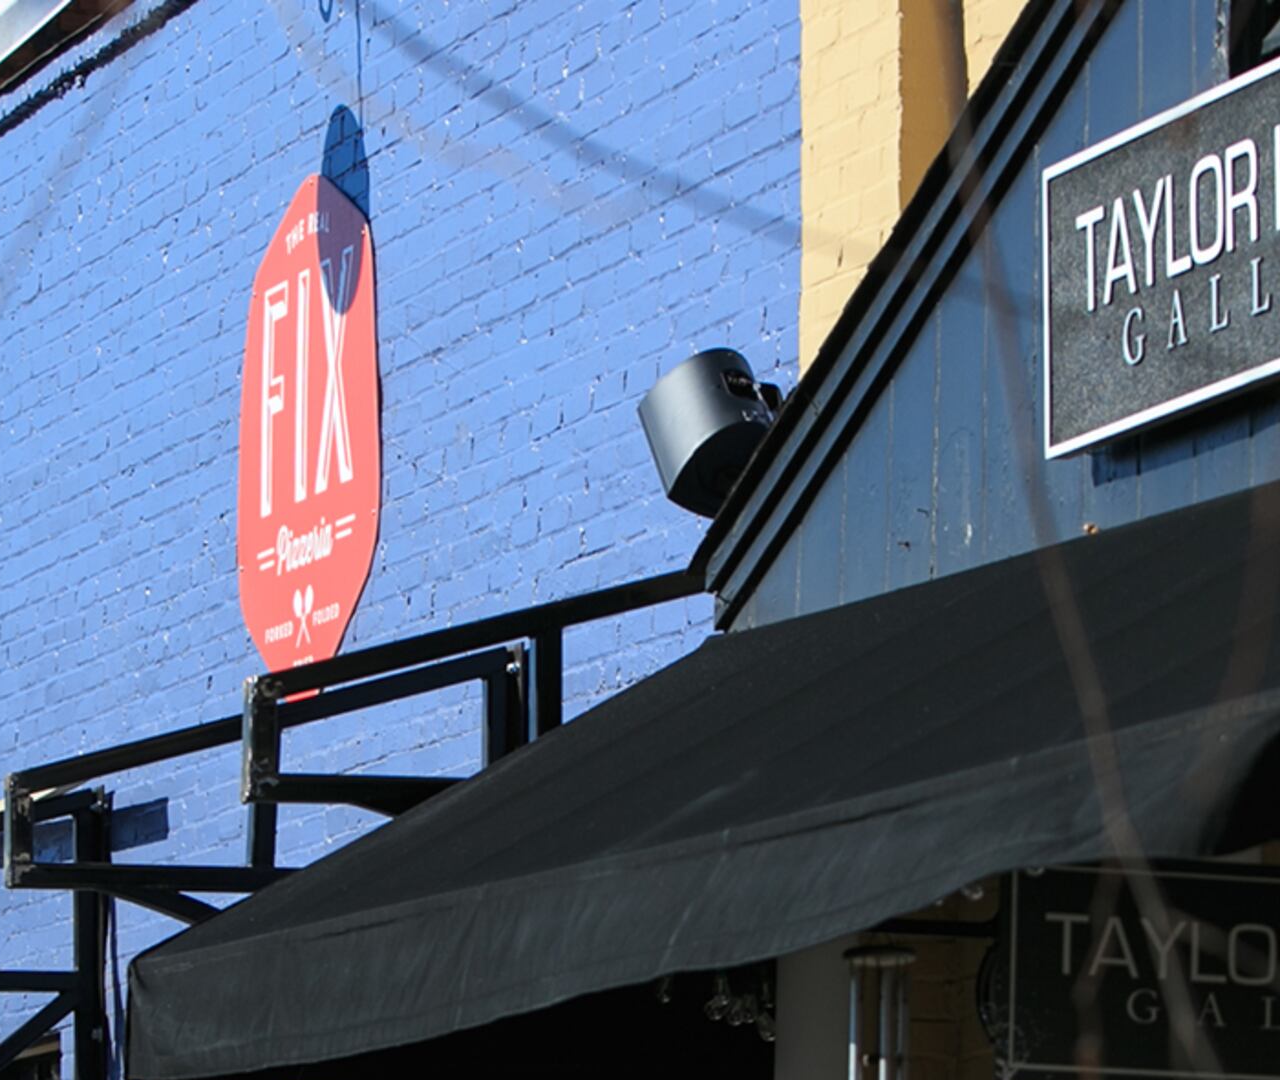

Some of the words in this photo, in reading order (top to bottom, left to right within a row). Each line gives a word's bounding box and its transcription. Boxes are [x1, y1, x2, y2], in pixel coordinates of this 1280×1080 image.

[285, 219, 305, 255] THE
[1075, 137, 1260, 312] TAYLOR
[260, 245, 354, 518] FIX
[276, 516, 333, 576] Pizzeria
